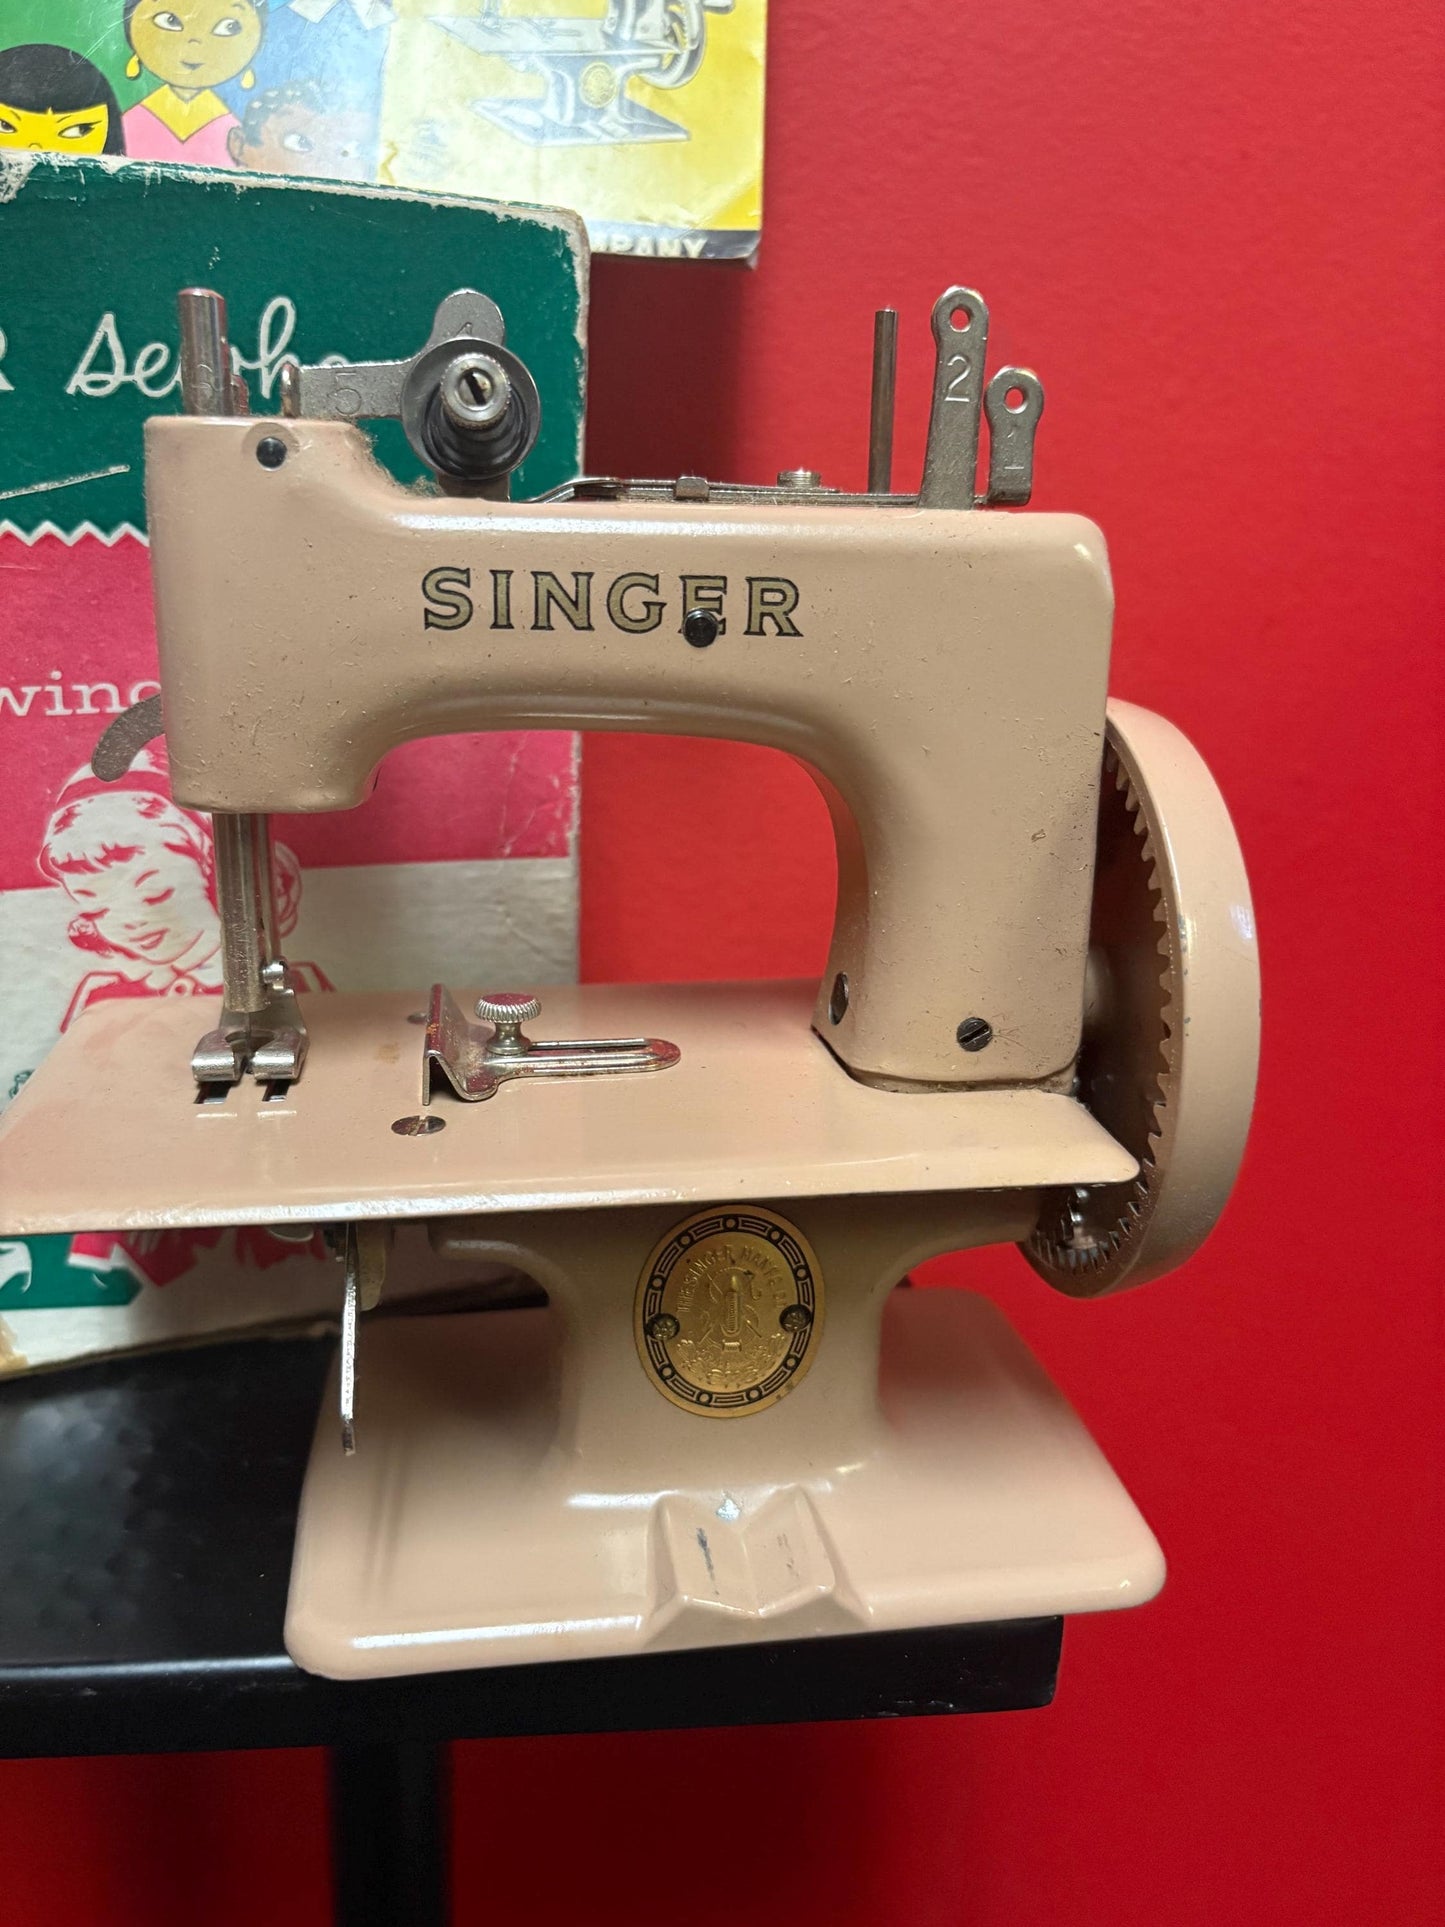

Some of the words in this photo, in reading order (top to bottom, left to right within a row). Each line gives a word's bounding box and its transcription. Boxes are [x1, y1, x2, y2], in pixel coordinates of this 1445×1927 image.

[327, 371, 362, 415] 5
[945, 355, 971, 402] 2
[421, 566, 804, 637] SINGER
